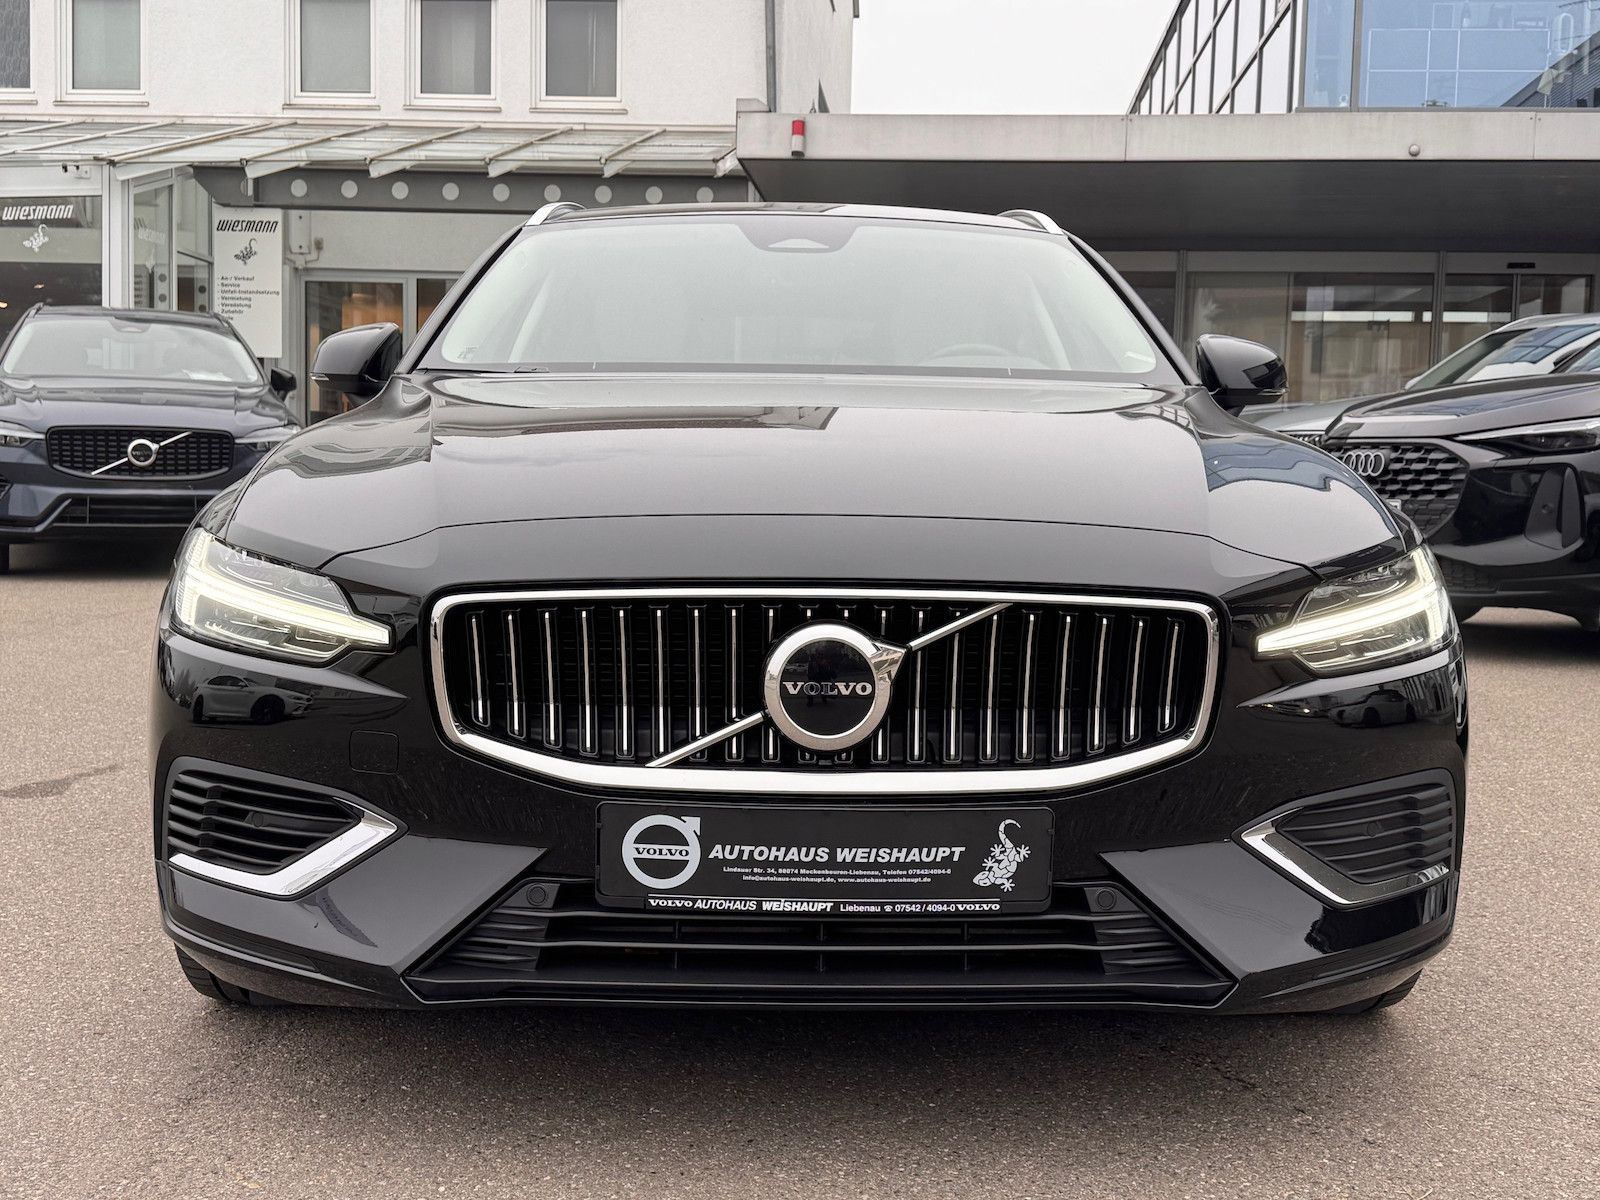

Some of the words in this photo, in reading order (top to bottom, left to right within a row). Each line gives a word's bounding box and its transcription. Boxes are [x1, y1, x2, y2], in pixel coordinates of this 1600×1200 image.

[782, 681, 873, 696] VOLVO
[633, 847, 690, 857] VOLVO
[708, 844, 830, 863] AUTOHAUS
[836, 846, 966, 863] WEISHAUPT
[837, 876, 932, 884] www.autohaus-weishaupt.de
[649, 899, 693, 907] VOLVO
[694, 899, 757, 911] AUTOHAUS
[762, 900, 834, 912] WEISHAUPT
[840, 903, 881, 912] Liebenau
[957, 903, 1000, 911] VOLVO
